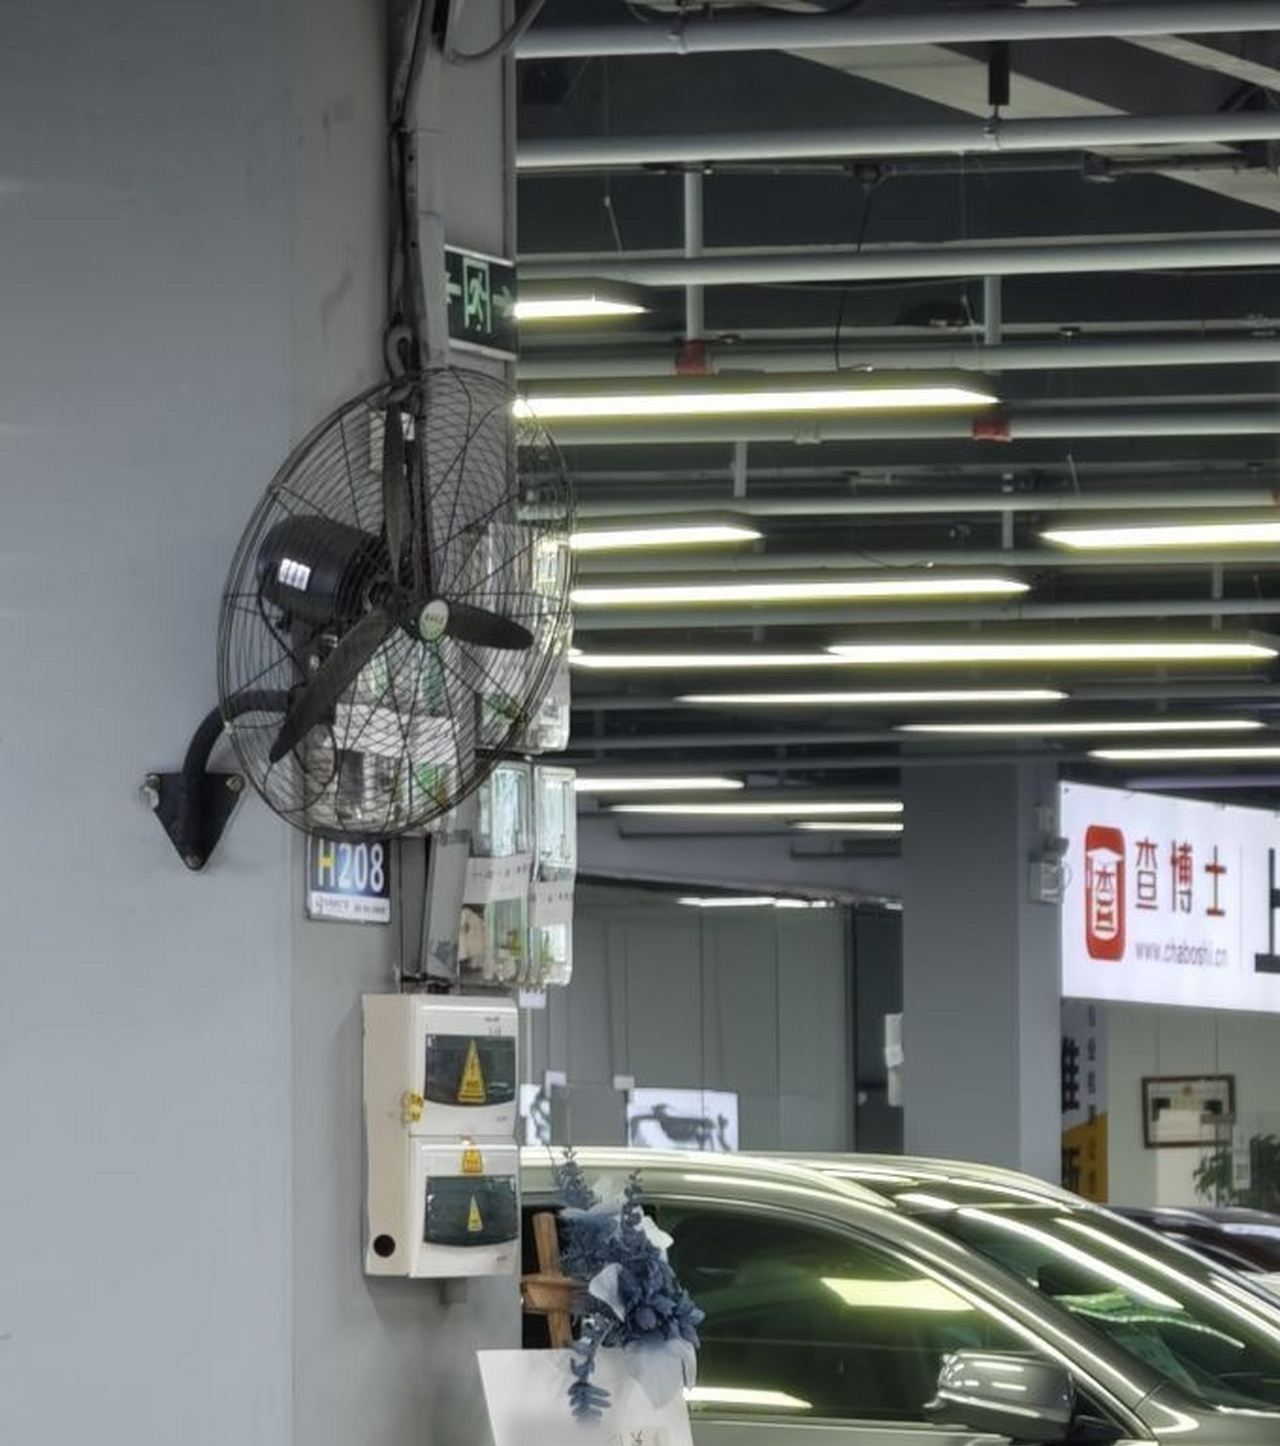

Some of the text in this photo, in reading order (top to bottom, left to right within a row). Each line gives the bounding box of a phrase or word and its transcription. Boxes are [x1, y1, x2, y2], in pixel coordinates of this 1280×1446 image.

[317, 837, 385, 893] H208
[1135, 837, 1227, 917] 查博士
